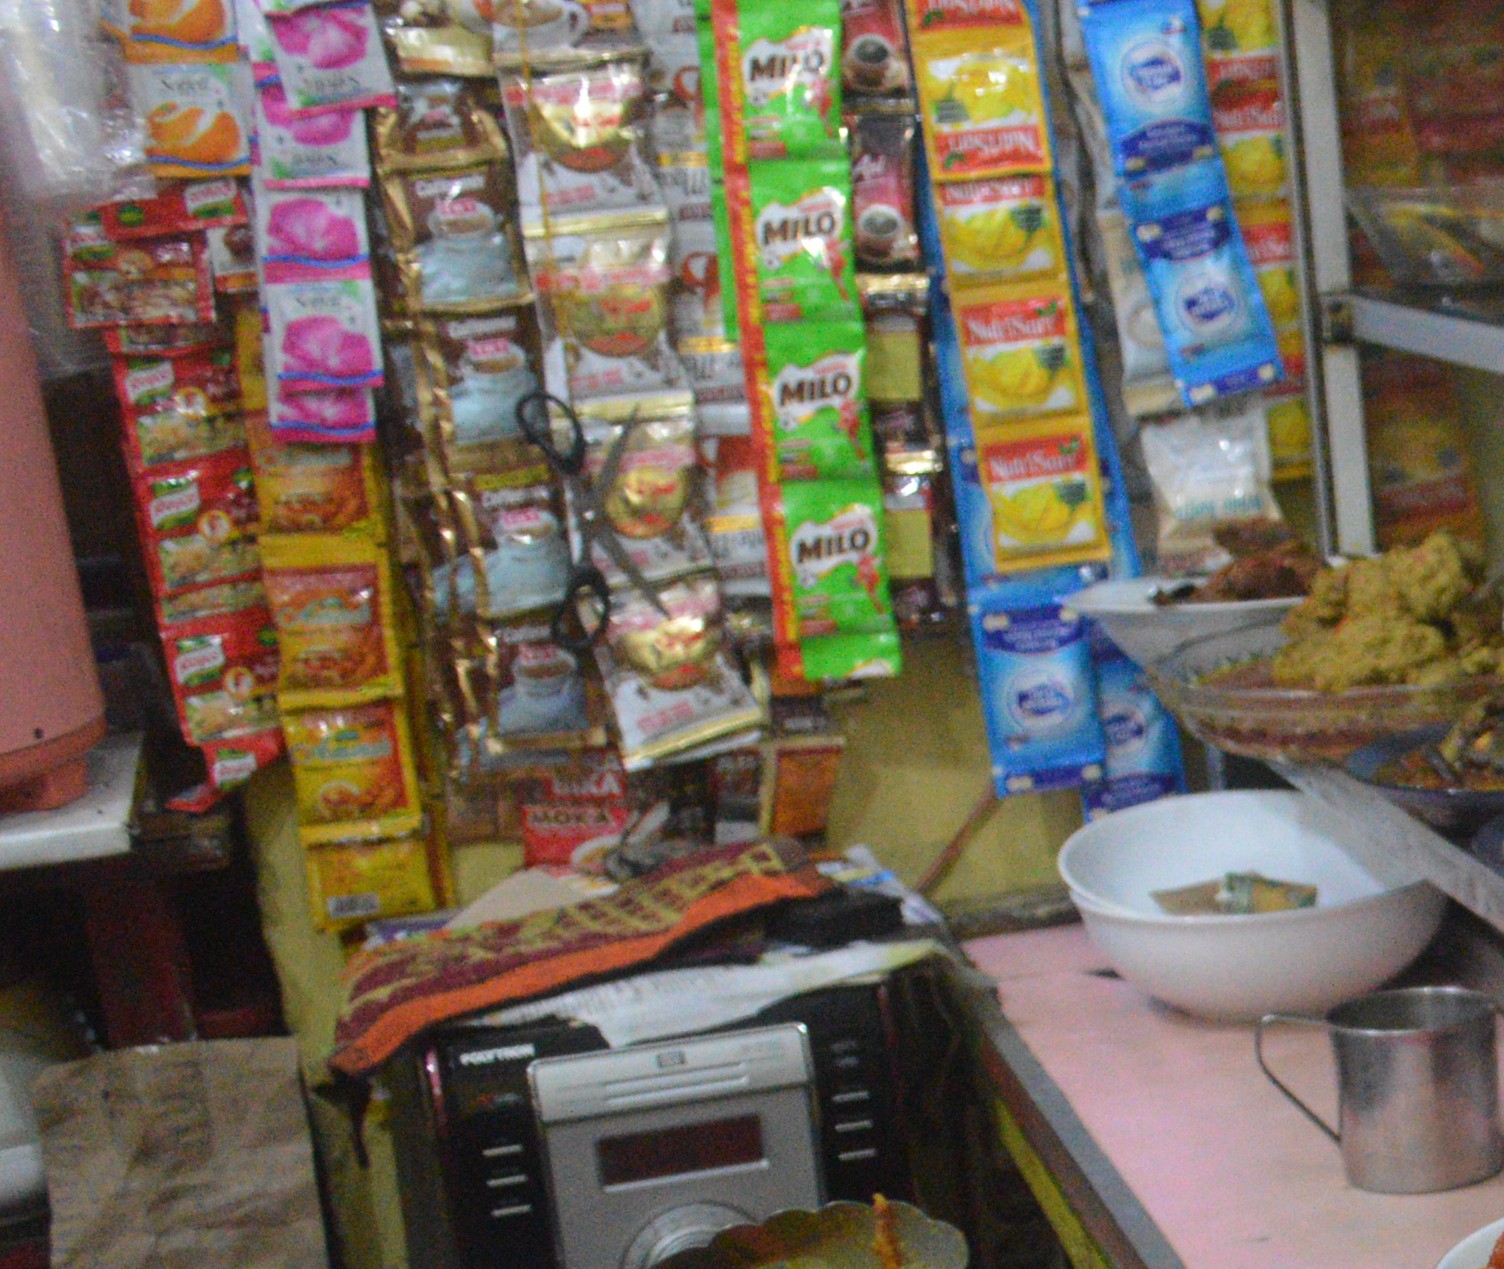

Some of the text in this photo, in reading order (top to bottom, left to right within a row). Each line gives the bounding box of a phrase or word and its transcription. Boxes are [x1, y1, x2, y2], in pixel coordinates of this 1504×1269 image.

[750, 49, 824, 81] MILO
[763, 211, 836, 246] MILO
[780, 372, 852, 406] MILO
[797, 527, 870, 564] MILO
